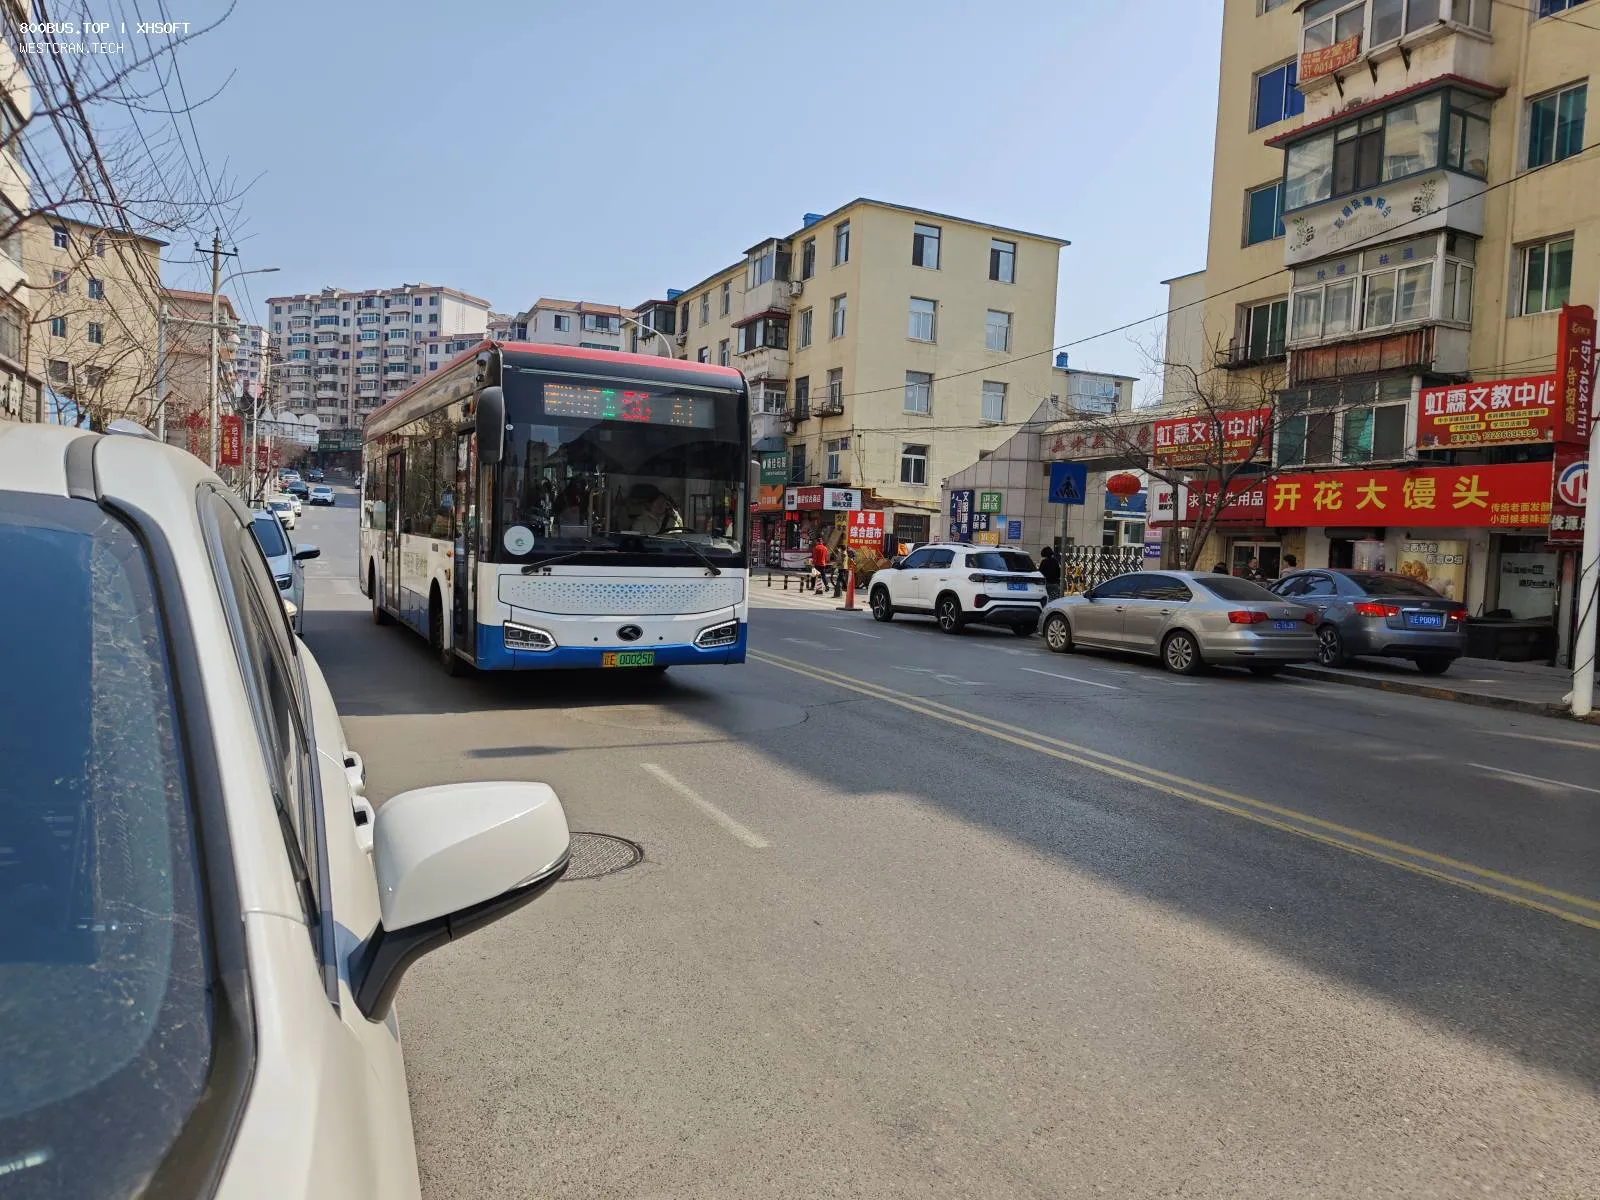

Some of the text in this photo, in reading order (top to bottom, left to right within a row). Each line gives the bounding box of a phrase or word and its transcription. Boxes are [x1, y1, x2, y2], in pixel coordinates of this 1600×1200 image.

[1576, 339, 1592, 437] 157-1424-1111
[1158, 503, 1173, 511] 晨光文
[1273, 475, 1490, 512] 开花大馒头
